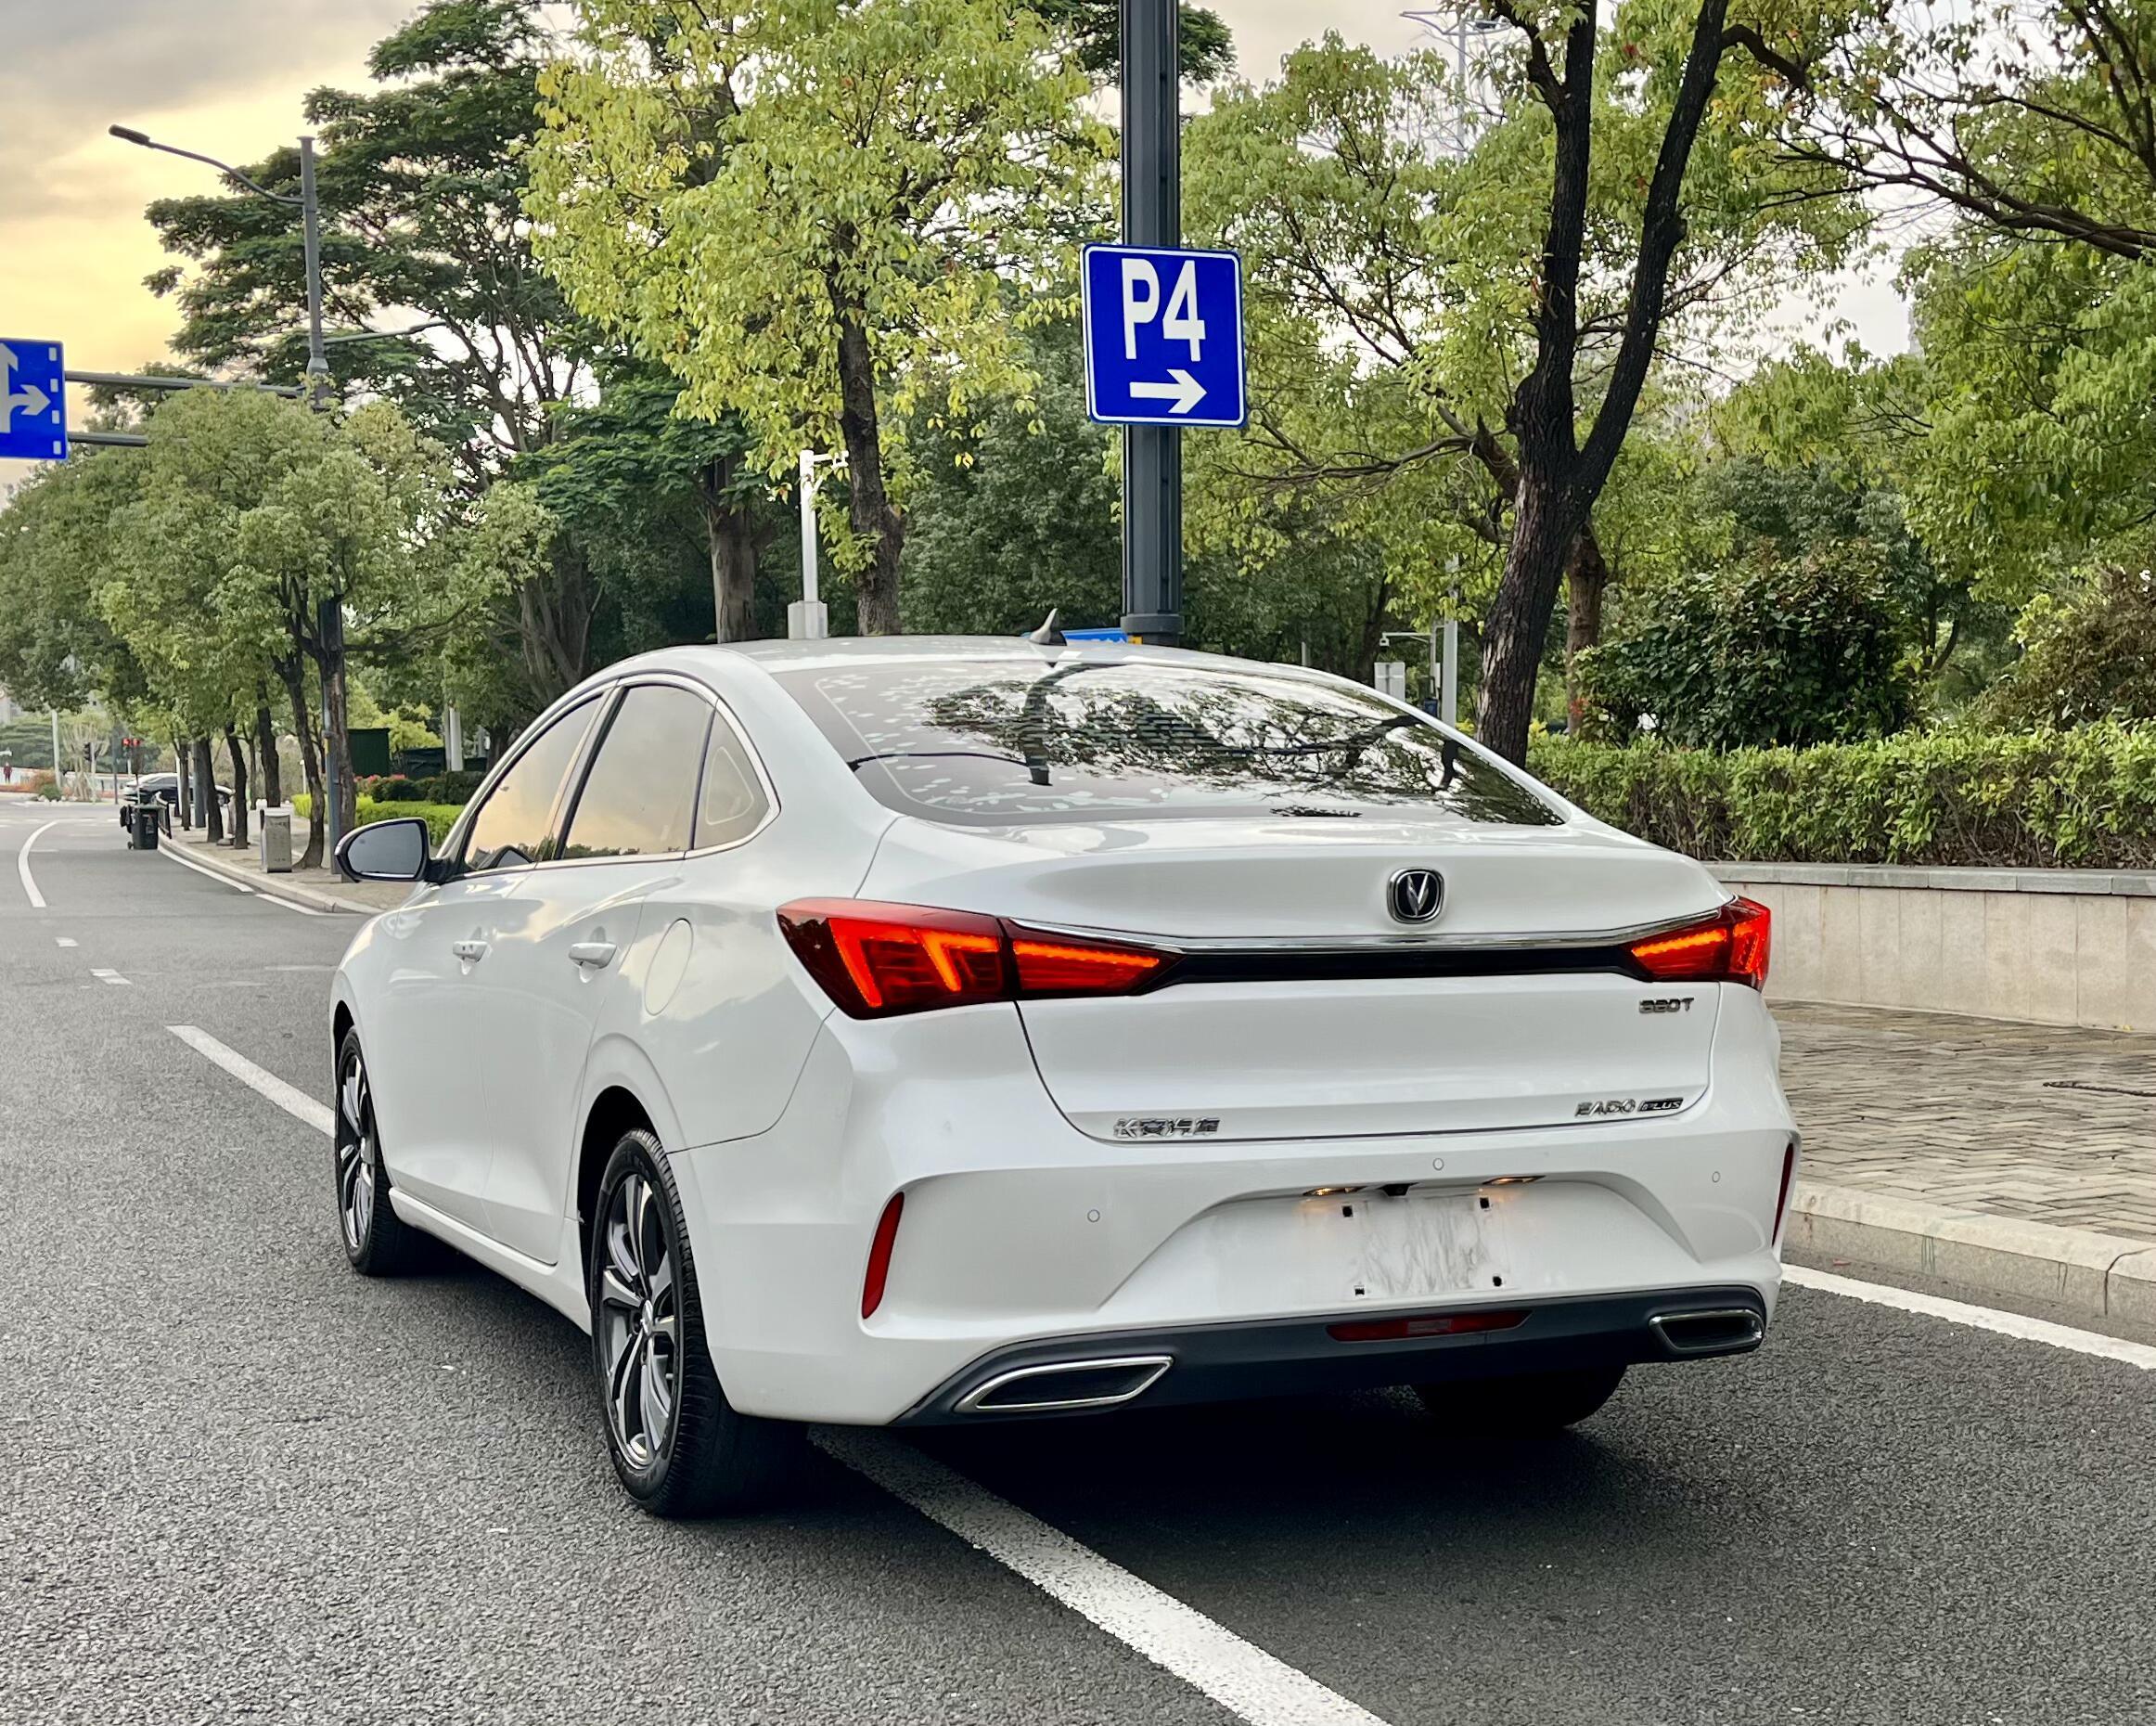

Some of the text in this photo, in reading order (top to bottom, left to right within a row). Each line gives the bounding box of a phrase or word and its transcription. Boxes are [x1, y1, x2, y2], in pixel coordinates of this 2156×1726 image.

[1122, 258, 1206, 362] P4
[1574, 1098, 1683, 1117] EADO PLUS
[1114, 1117, 1220, 1138] 长安汽车
